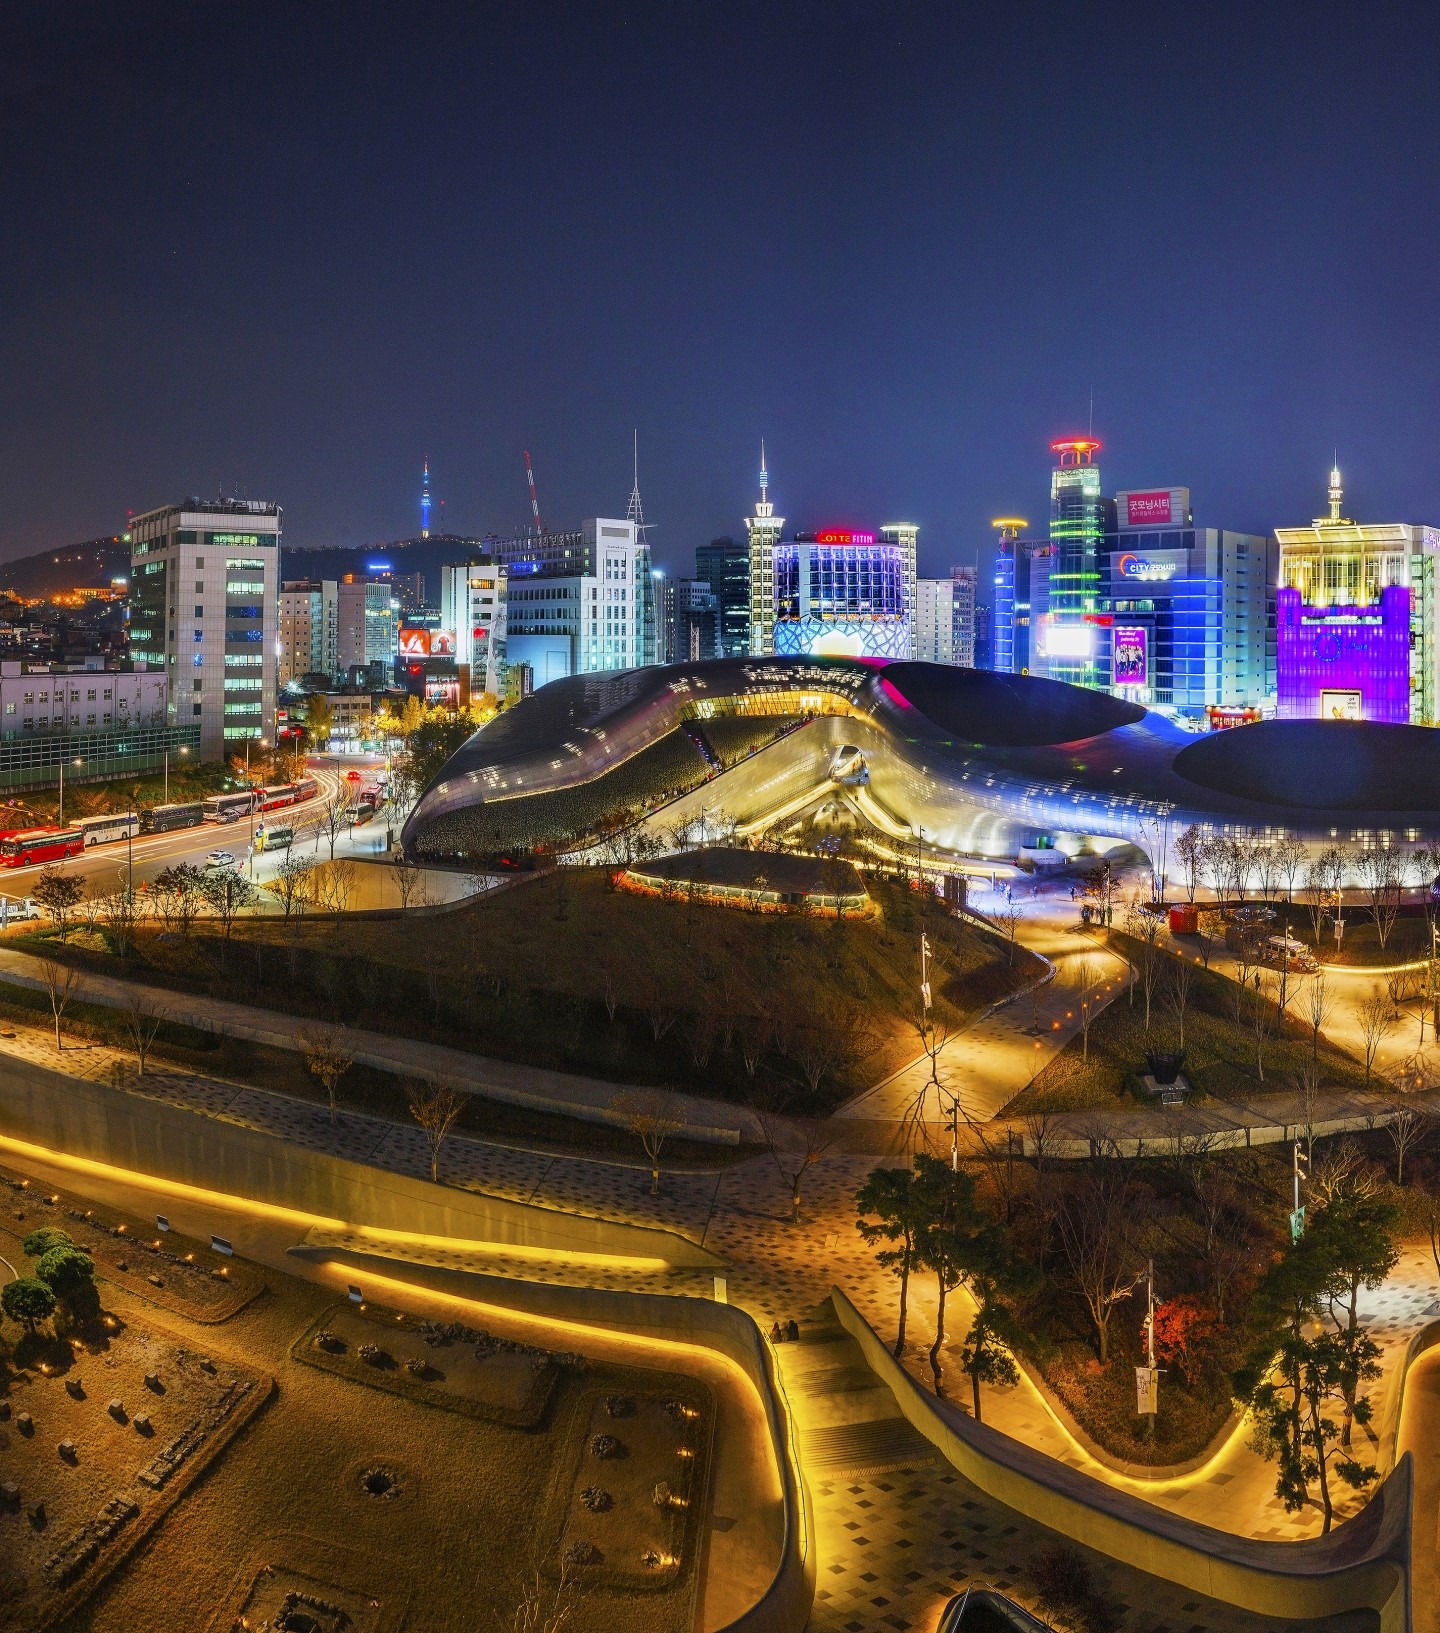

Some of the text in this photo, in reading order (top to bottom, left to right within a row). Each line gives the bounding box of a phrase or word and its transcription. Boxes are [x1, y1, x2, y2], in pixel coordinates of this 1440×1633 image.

[1130, 498, 1170, 511] 굿모닝시티
[852, 534, 873, 543] FITIN
[1130, 564, 1149, 572] CITY
